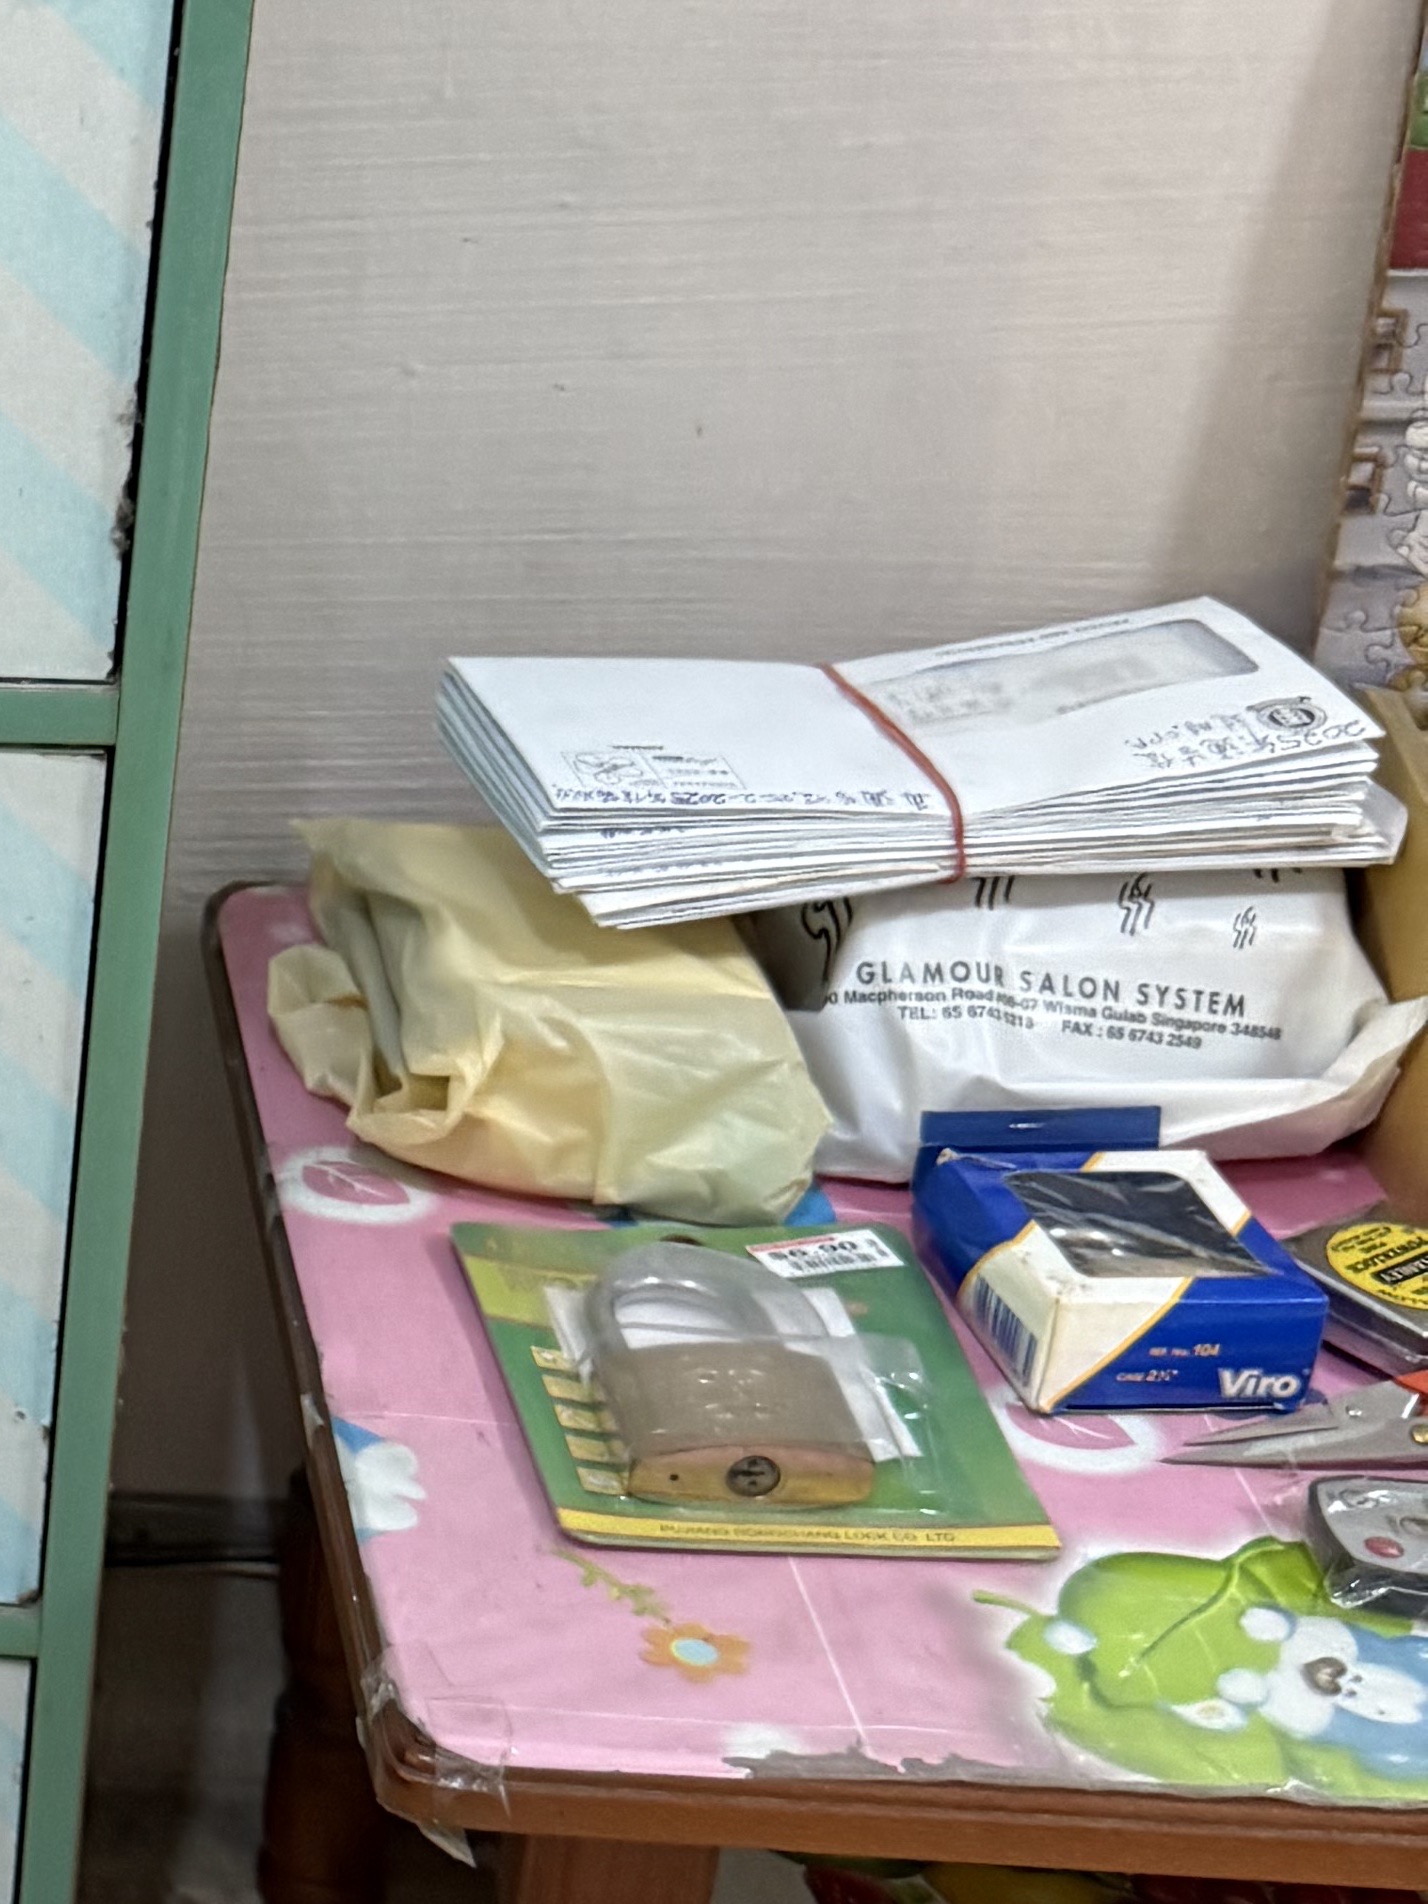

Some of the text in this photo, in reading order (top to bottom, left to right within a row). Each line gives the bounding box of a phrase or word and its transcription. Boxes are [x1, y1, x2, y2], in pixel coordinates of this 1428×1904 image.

[844, 988, 946, 1007] Macpherson
[951, 986, 993, 1002] Road
[1044, 998, 1097, 1019] Wisma
[1151, 1012, 1227, 1035] Singapore
[856, 960, 1245, 1018] GLAMOUR SALON SYSTEM
[1218, 1367, 1302, 1399] Viro
